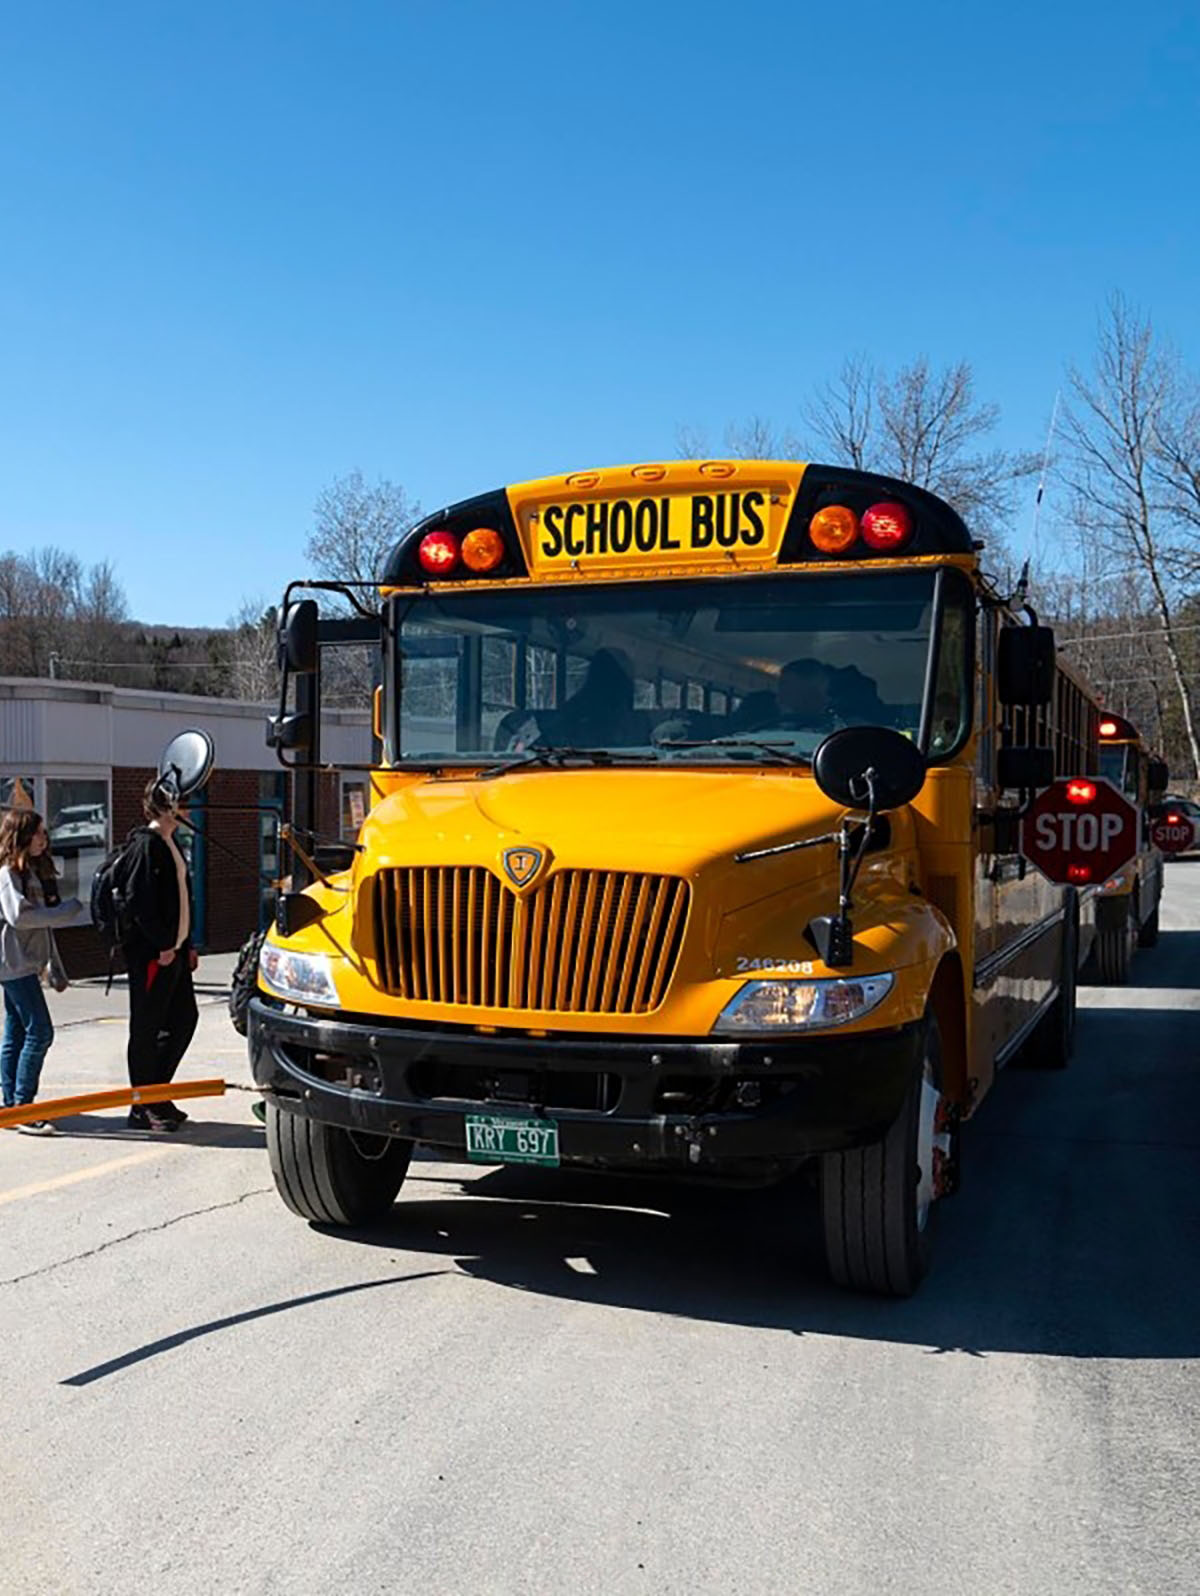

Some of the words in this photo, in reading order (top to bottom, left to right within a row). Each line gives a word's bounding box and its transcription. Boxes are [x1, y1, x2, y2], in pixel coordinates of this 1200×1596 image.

[542, 497, 681, 557] SCHOOL
[690, 491, 765, 548] BUS
[1035, 813, 1124, 852] STOP
[1155, 826, 1190, 841] STOP
[474, 1126, 505, 1150] KRY
[516, 1129, 549, 1154] 697
